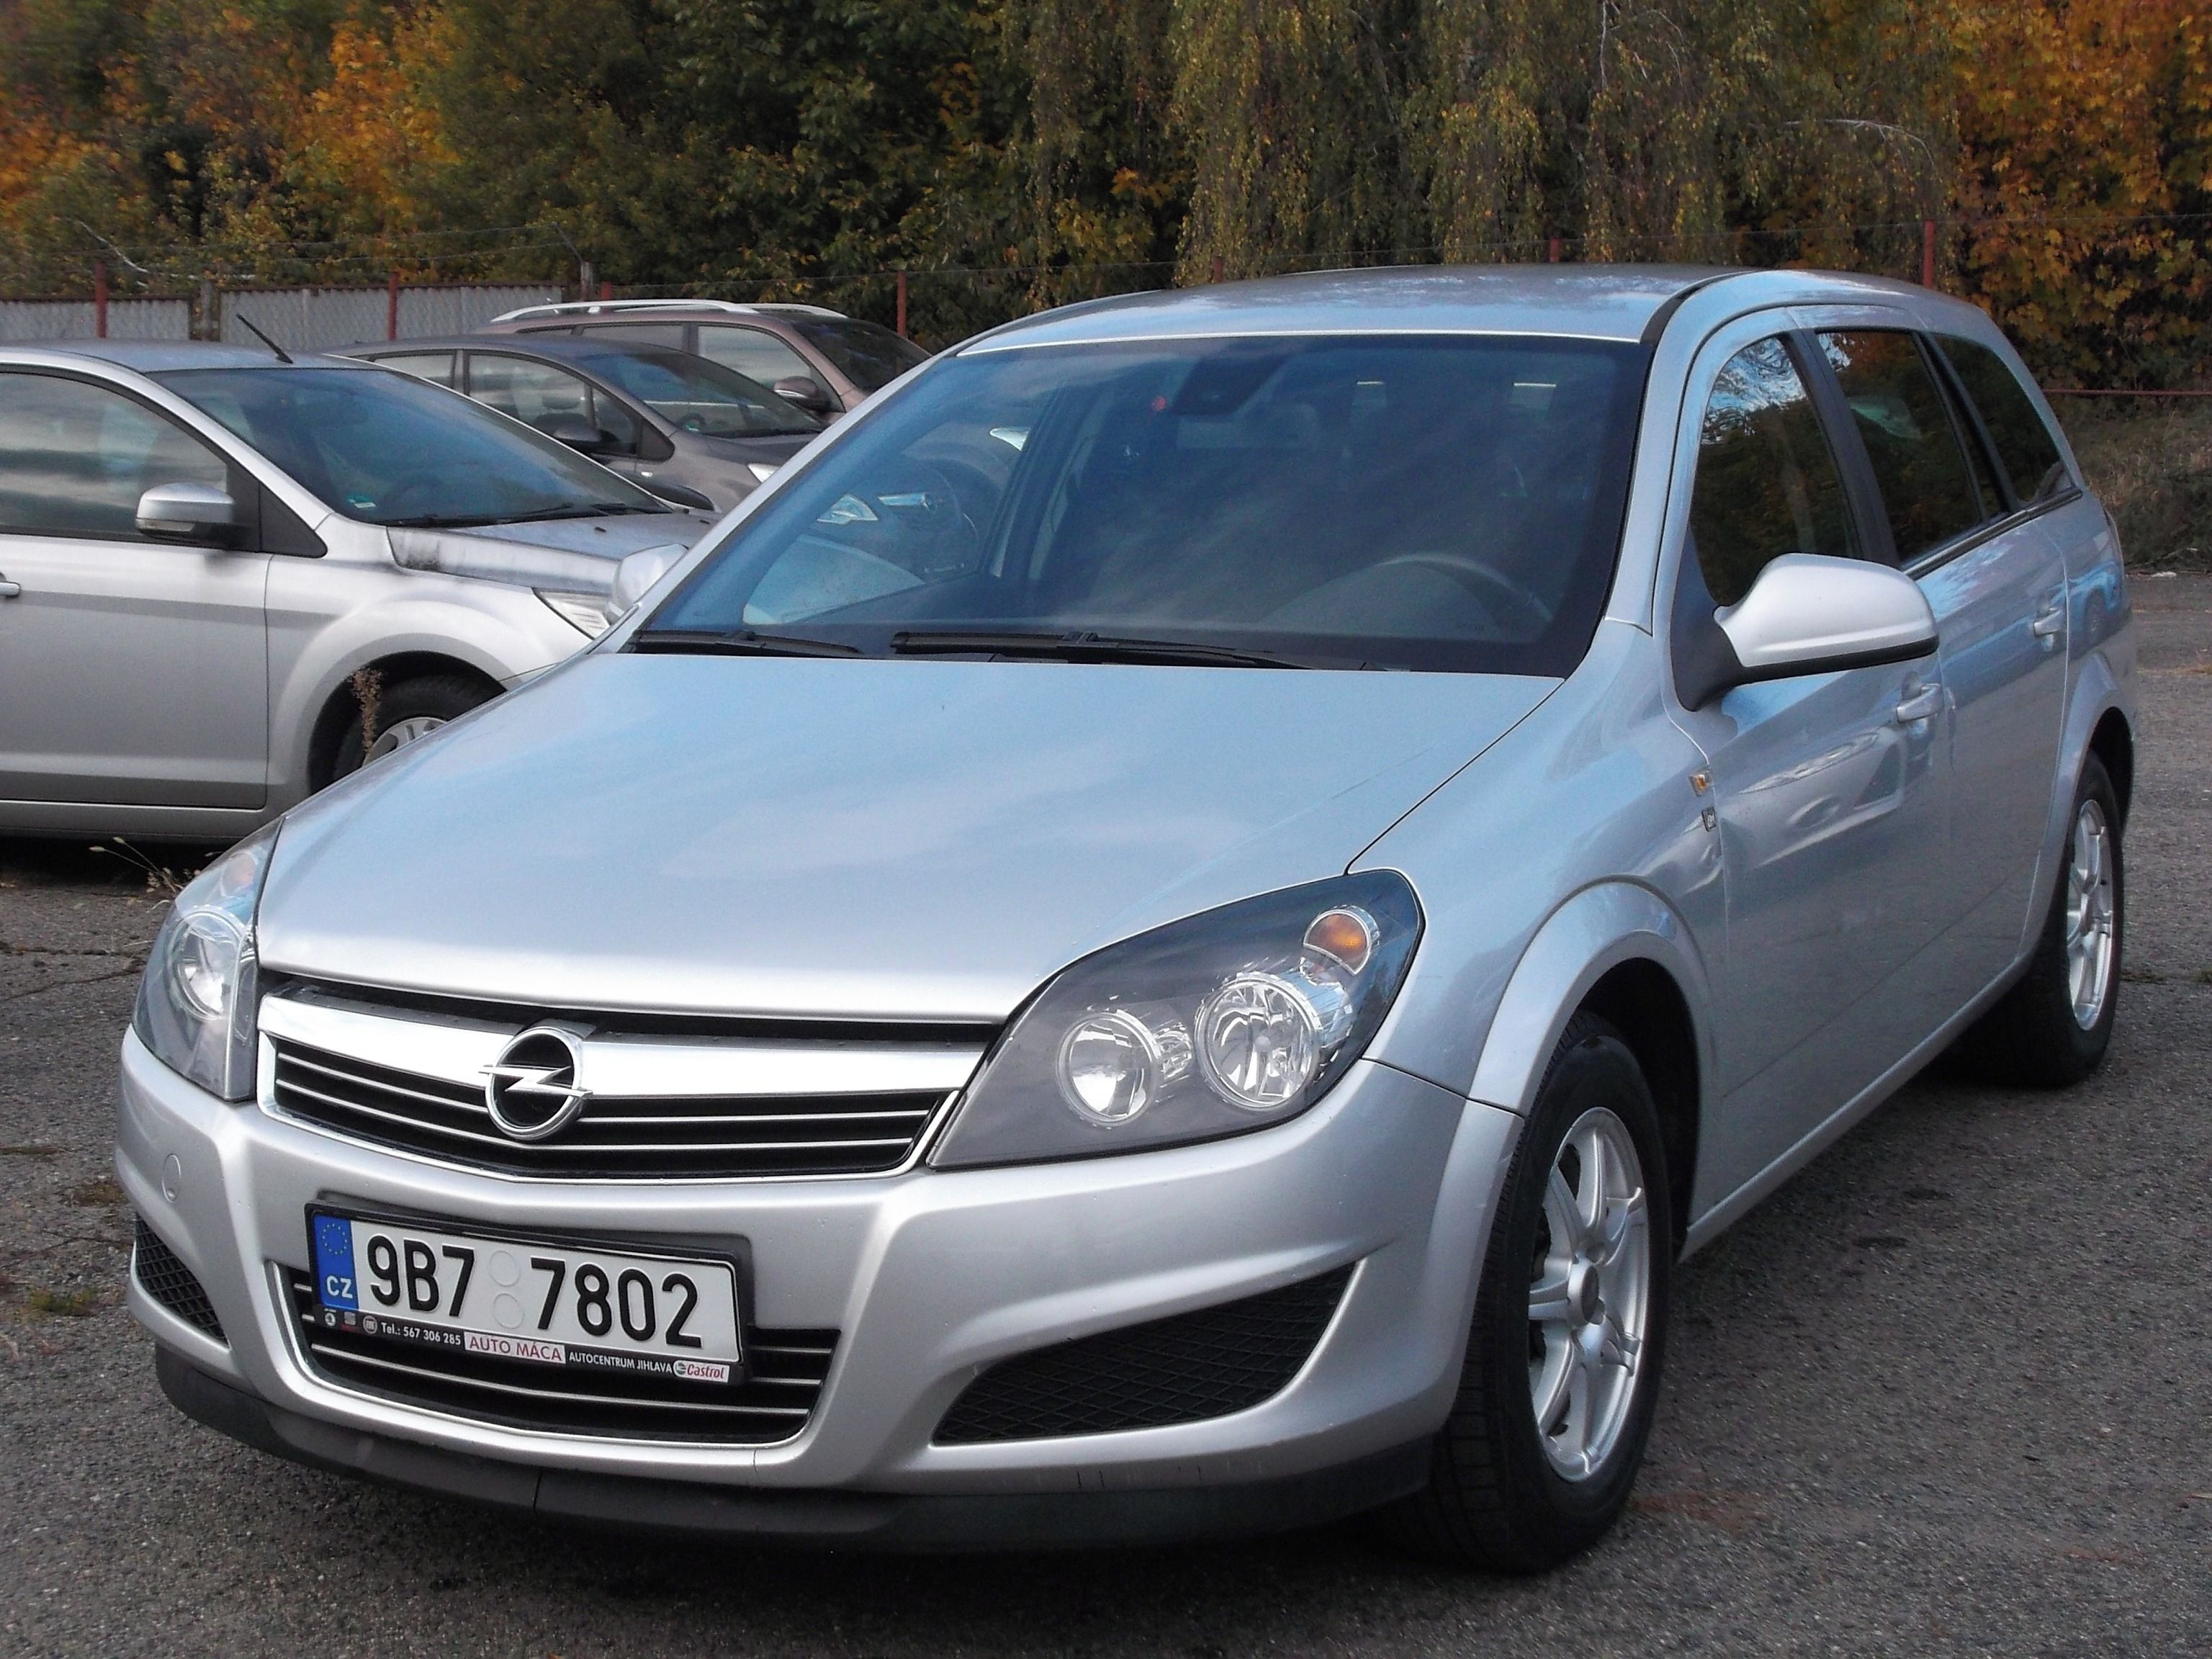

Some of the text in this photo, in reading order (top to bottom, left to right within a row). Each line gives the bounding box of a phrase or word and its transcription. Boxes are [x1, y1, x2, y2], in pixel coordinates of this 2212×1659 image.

[326, 1275, 353, 1299] CZ
[367, 1233, 703, 1349] 9B7 7802
[382, 1322, 401, 1335] Tel.:
[403, 1326, 420, 1338] 567
[423, 1330, 441, 1341] 306
[443, 1334, 461, 1344] 285
[471, 1336, 562, 1361] AUTO MÁCA
[569, 1352, 672, 1373] AUTOCENTRUM JIHLAVA
[687, 1364, 724, 1379] Castrol
